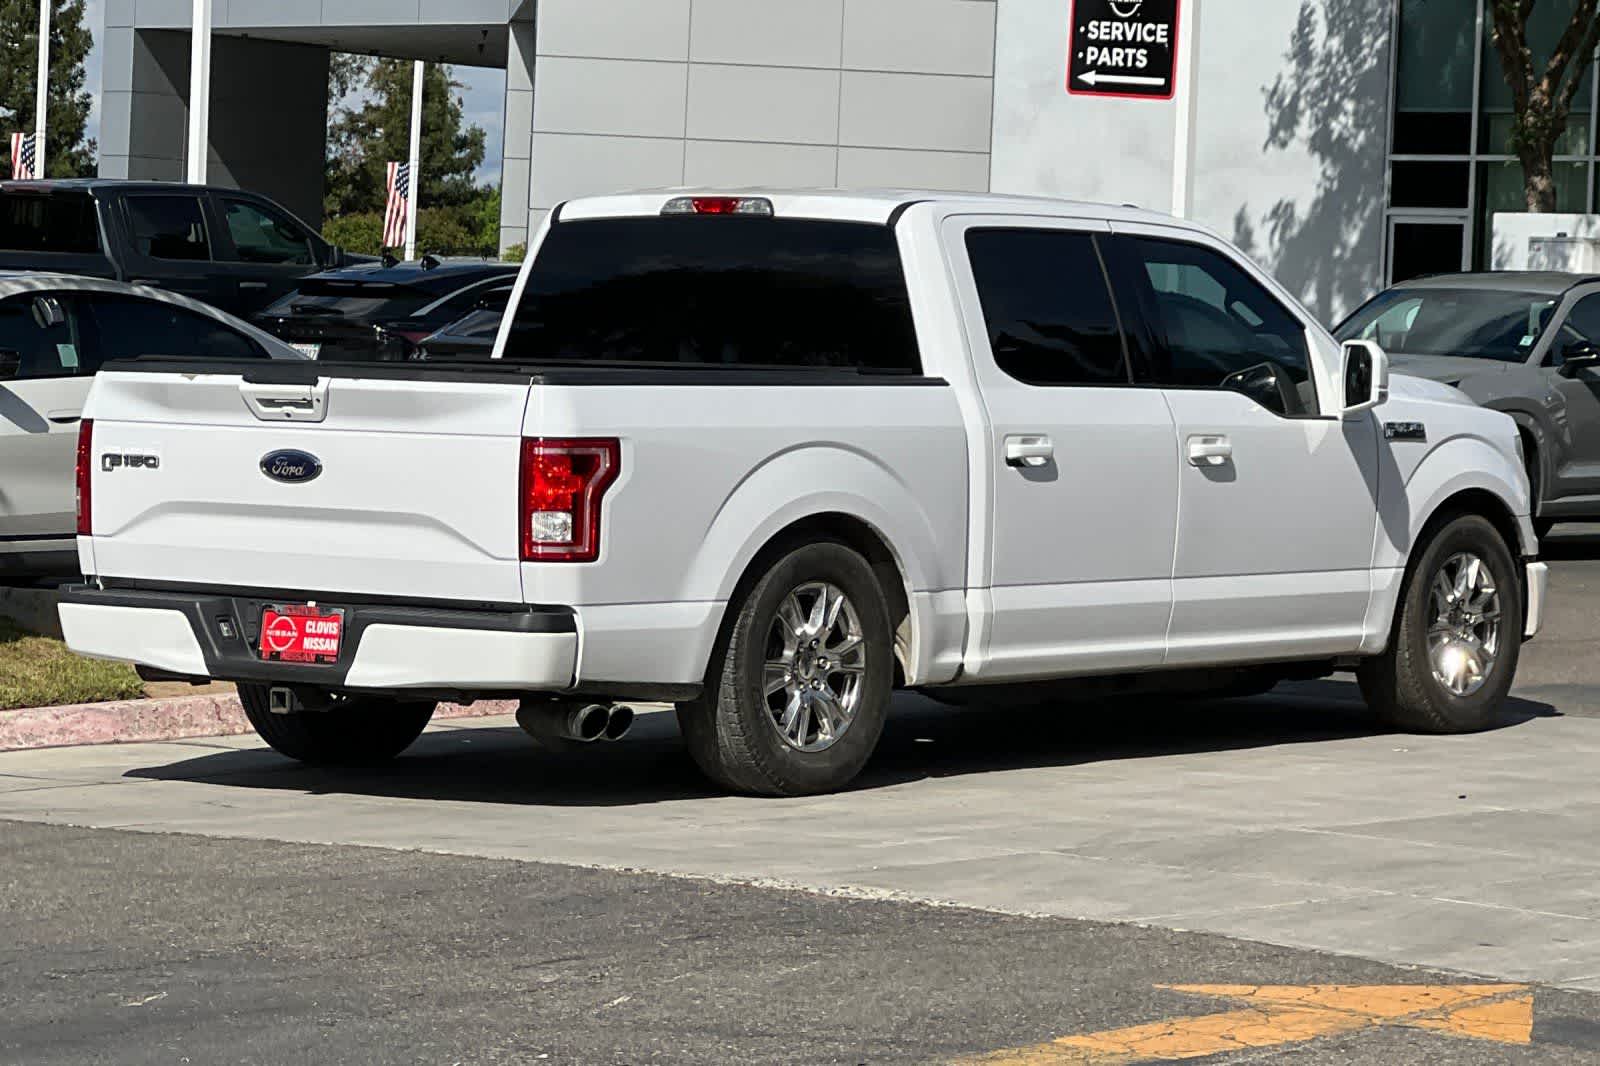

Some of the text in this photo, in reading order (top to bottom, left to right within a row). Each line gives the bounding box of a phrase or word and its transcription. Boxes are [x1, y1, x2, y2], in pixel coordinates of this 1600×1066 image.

[1087, 20, 1169, 43] SERVICE
[1086, 46, 1148, 68] PARTS
[271, 456, 306, 476] Ford
[266, 629, 297, 637] NISSAN
[305, 620, 338, 634] CLOVIS
[303, 637, 338, 651] NISSAN
